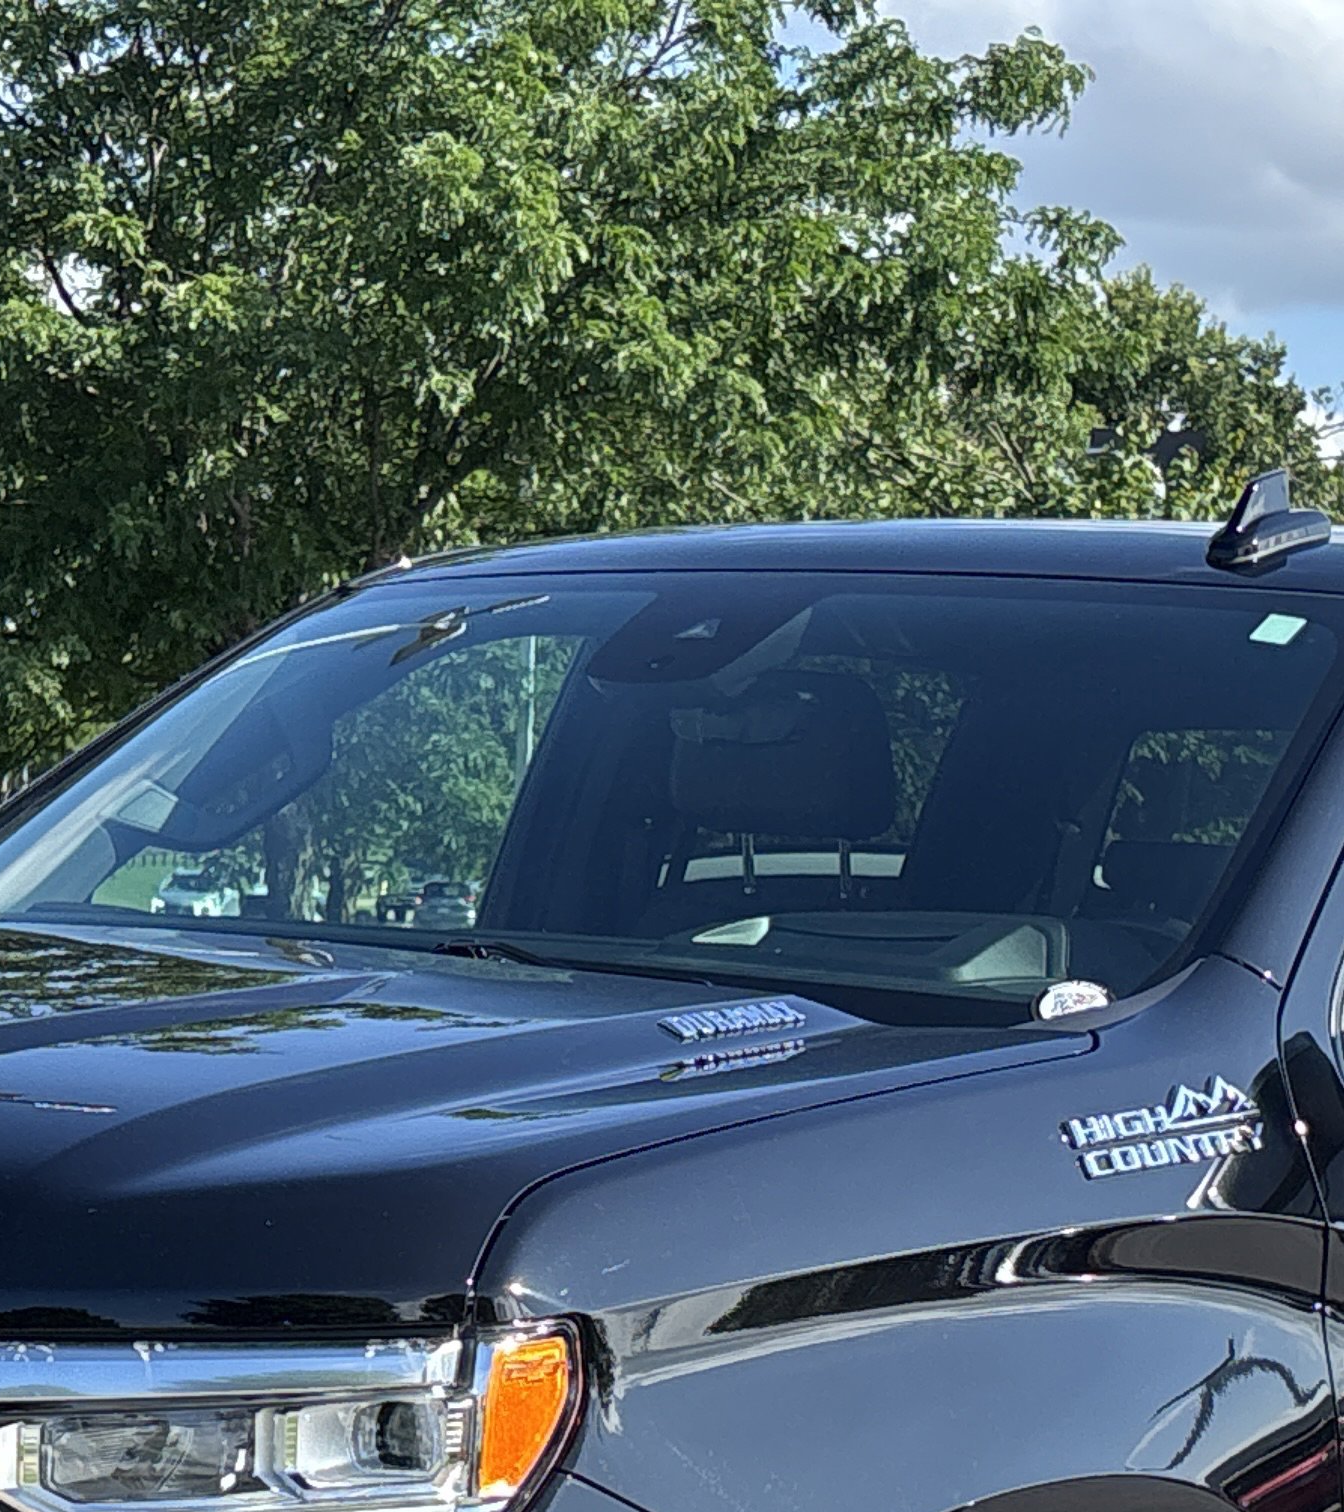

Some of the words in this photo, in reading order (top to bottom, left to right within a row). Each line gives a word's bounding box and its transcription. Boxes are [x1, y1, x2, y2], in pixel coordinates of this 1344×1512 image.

[657, 1001, 806, 1044] DURAMAX
[1064, 1105, 1170, 1149] HIGH
[1079, 1122, 1264, 1178] COUNTRY
